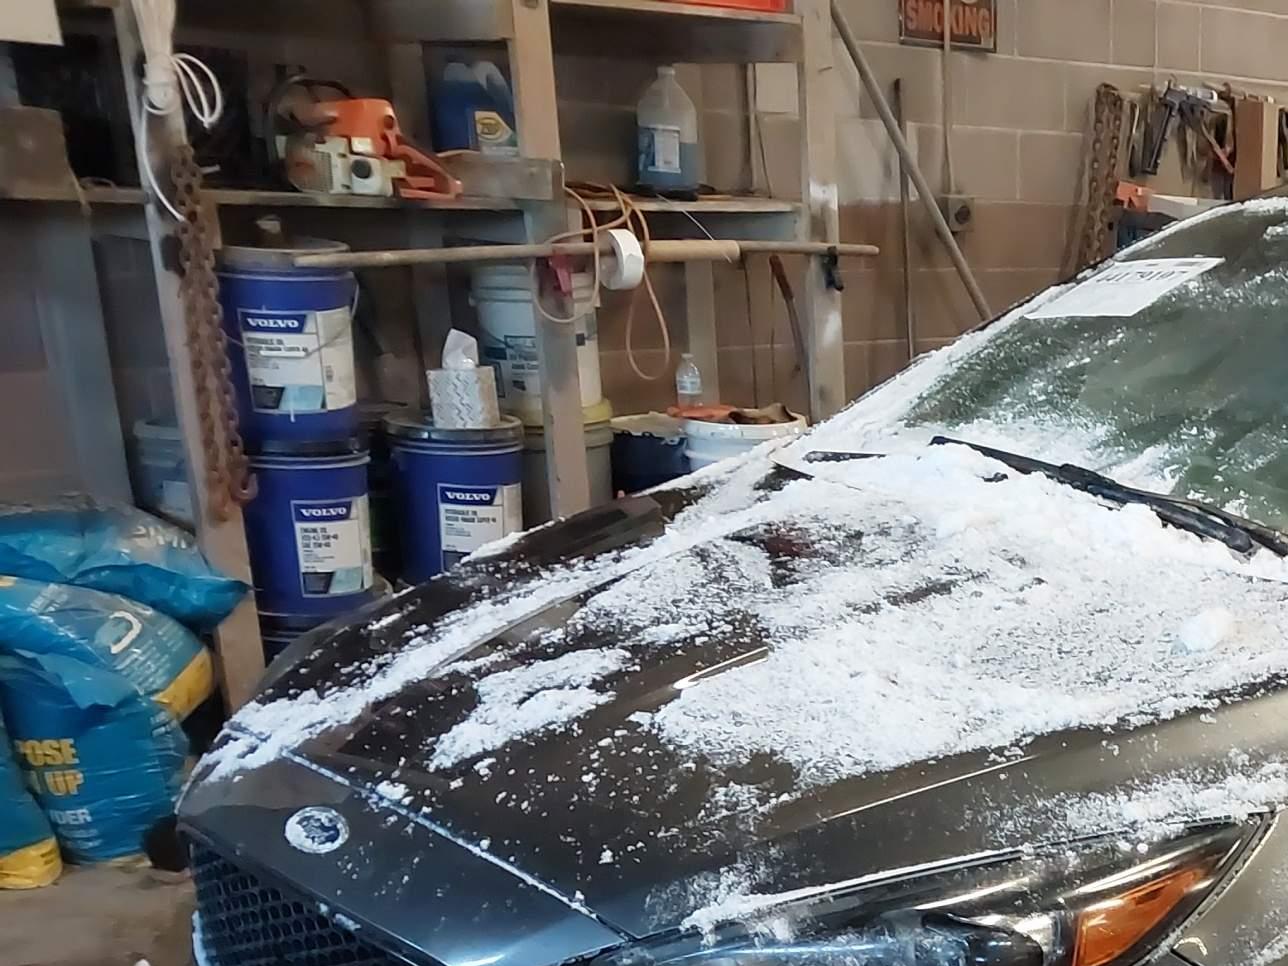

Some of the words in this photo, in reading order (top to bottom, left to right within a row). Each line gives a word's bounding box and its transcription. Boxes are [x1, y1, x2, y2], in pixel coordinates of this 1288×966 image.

[247, 318, 299, 328] VOLVO
[445, 491, 491, 501] VOLVO
[300, 507, 347, 517] VOLVO
